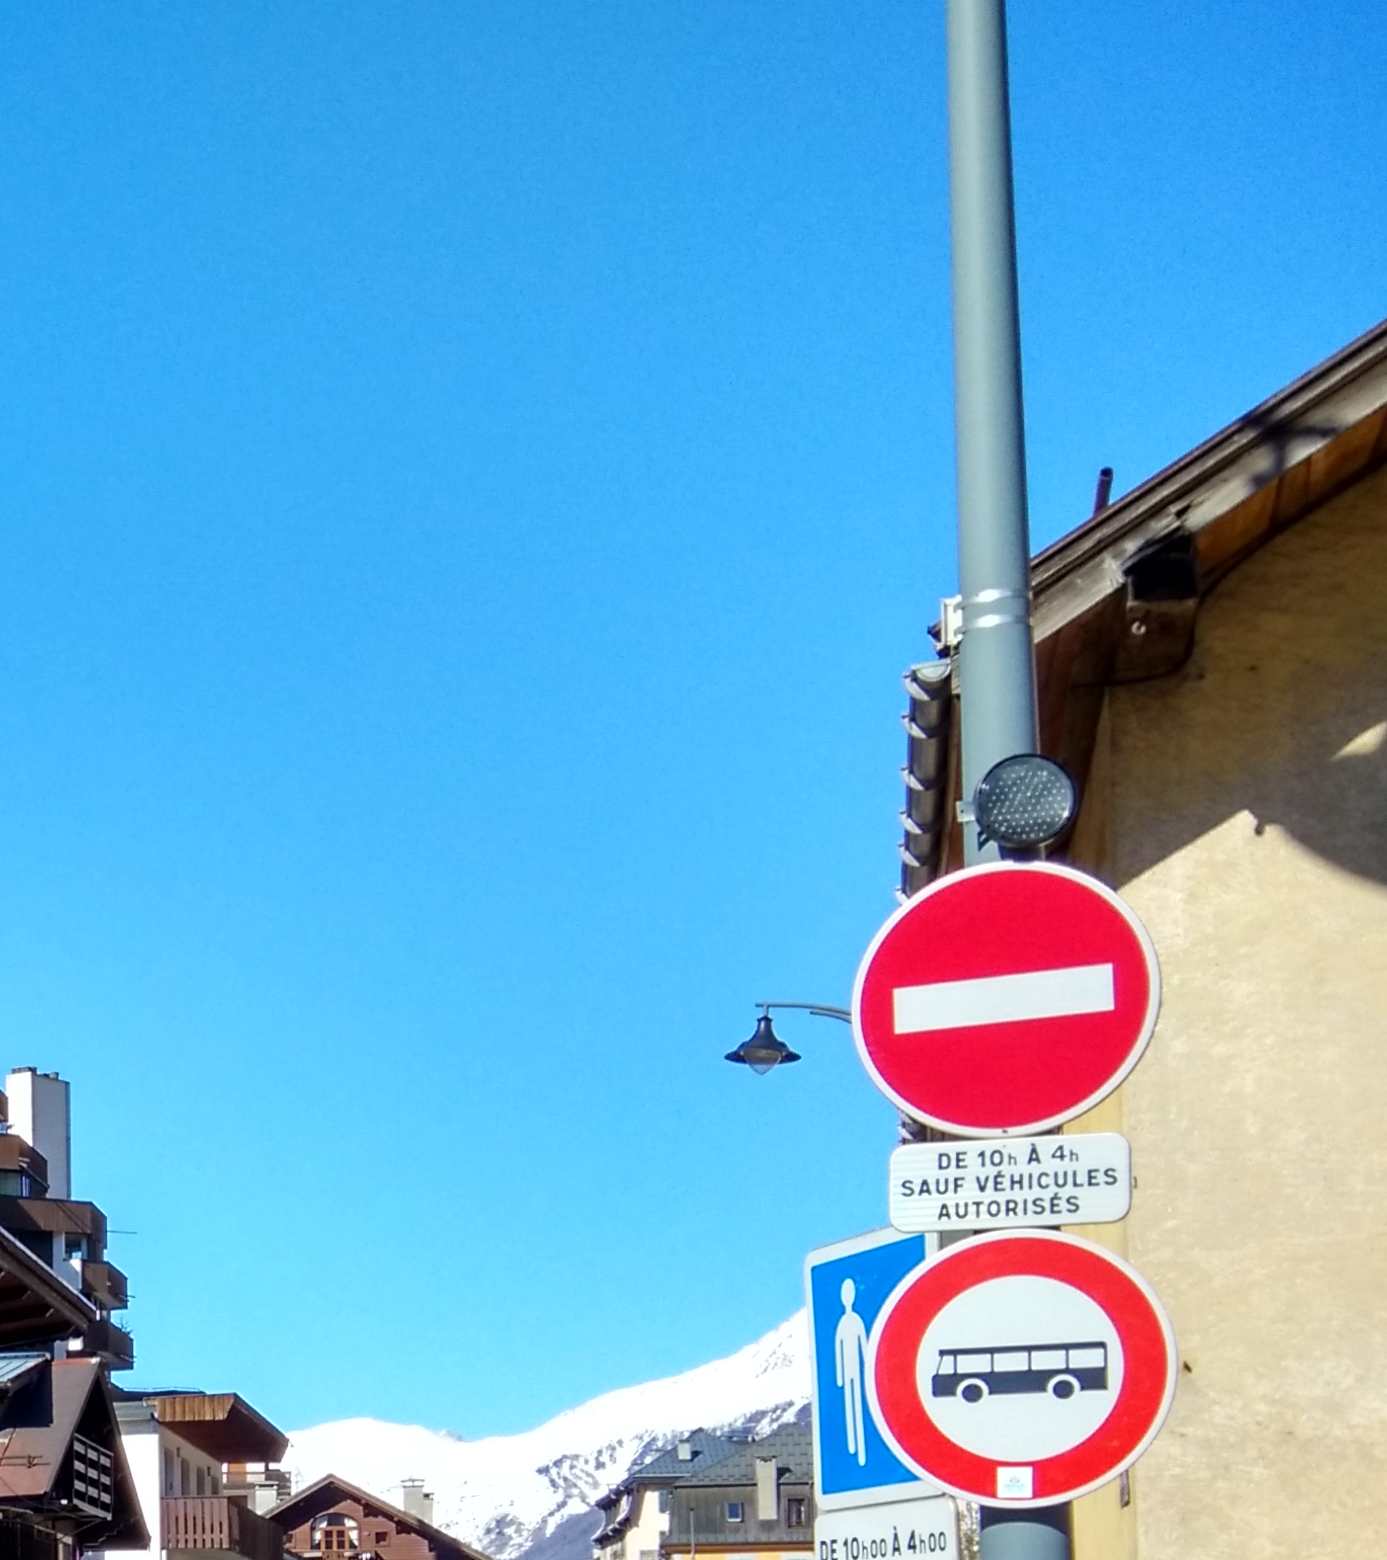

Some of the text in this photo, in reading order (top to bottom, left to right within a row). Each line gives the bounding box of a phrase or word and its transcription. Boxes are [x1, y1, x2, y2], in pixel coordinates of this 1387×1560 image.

[937, 1142, 1079, 1171] DE 10h À 4h
[900, 1167, 1119, 1198] SAUF VÉHICULES
[937, 1194, 1081, 1221] AUTORISÉS
[891, 1526, 902, 1557] À
[906, 1531, 947, 1555] 4h00
